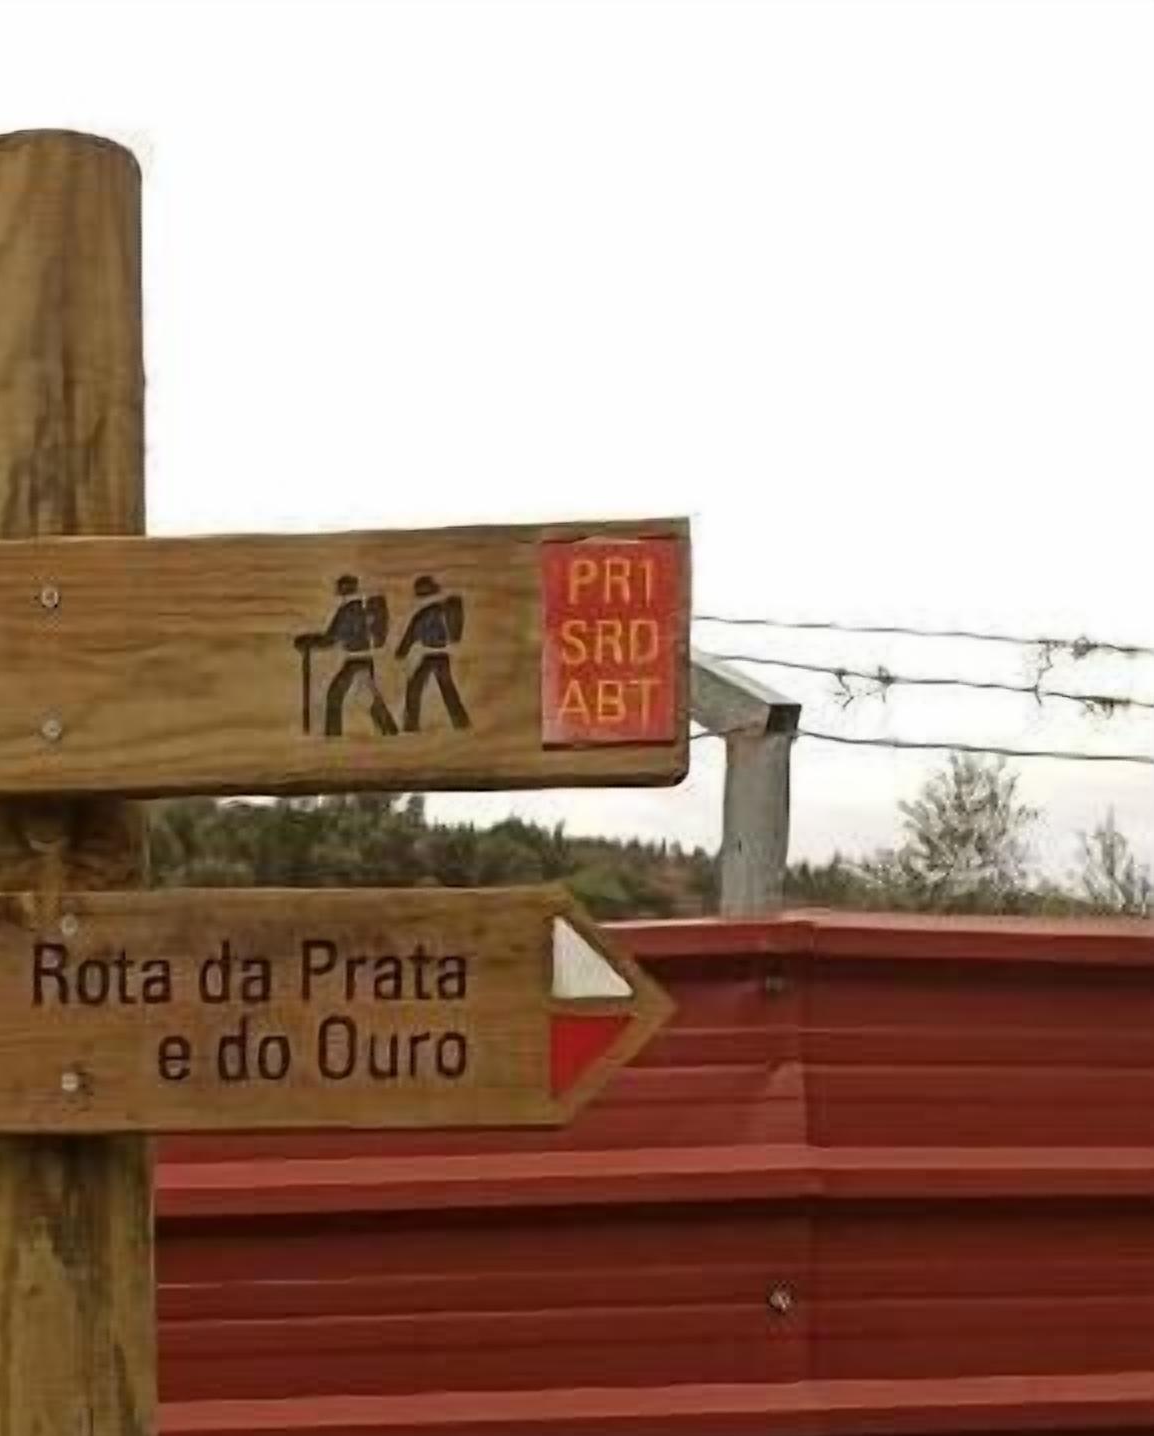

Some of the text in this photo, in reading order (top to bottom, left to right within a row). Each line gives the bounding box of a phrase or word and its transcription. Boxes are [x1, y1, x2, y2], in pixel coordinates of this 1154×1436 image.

[568, 556, 654, 607] PR1
[560, 619, 659, 666] SRD
[557, 679, 662, 727] ABT
[30, 939, 467, 1006] Rota da Prata
[158, 1014, 467, 1081] e do Ouro
